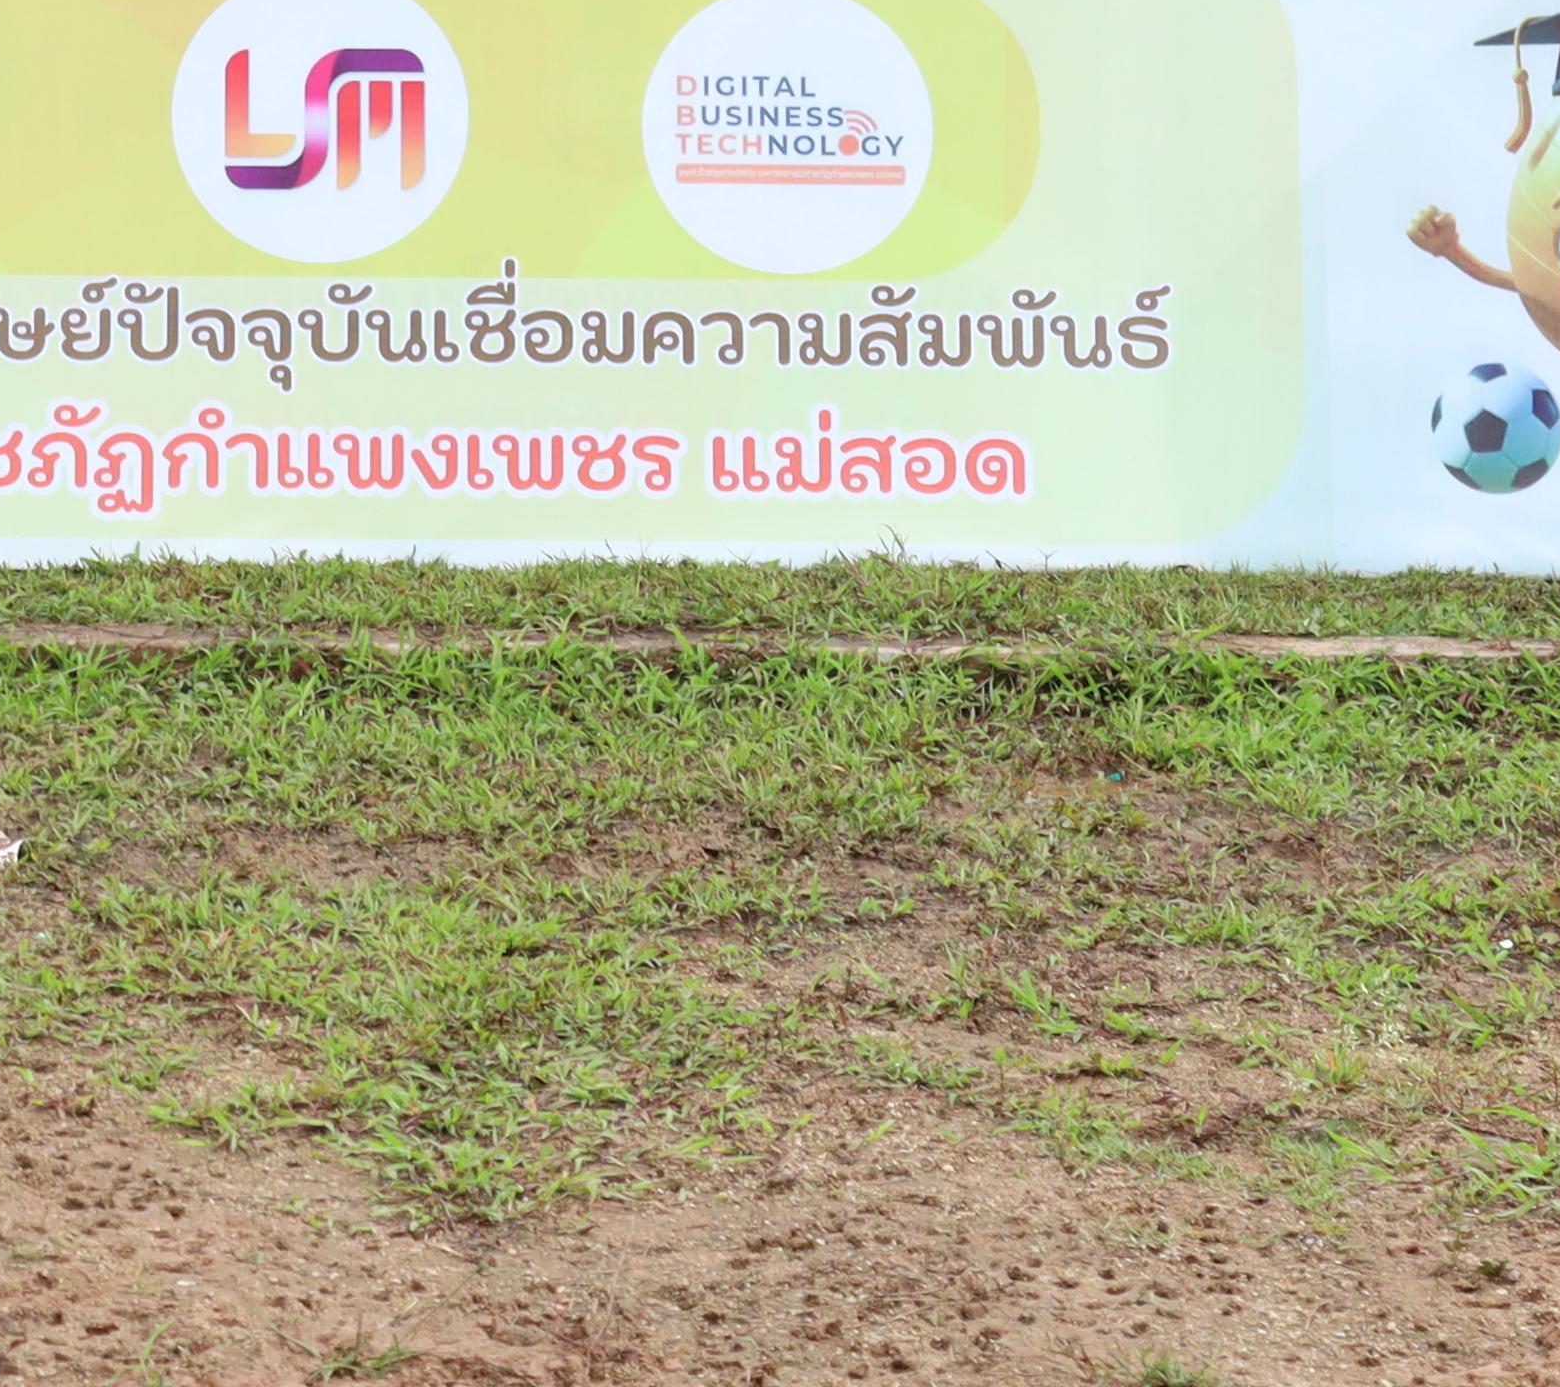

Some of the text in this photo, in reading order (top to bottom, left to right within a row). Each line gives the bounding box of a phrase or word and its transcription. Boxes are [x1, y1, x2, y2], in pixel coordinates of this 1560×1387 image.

[676, 75, 816, 97] DIGITAL
[677, 105, 845, 127] BUSINESS
[712, 408, 1027, 496] แม่สอด
